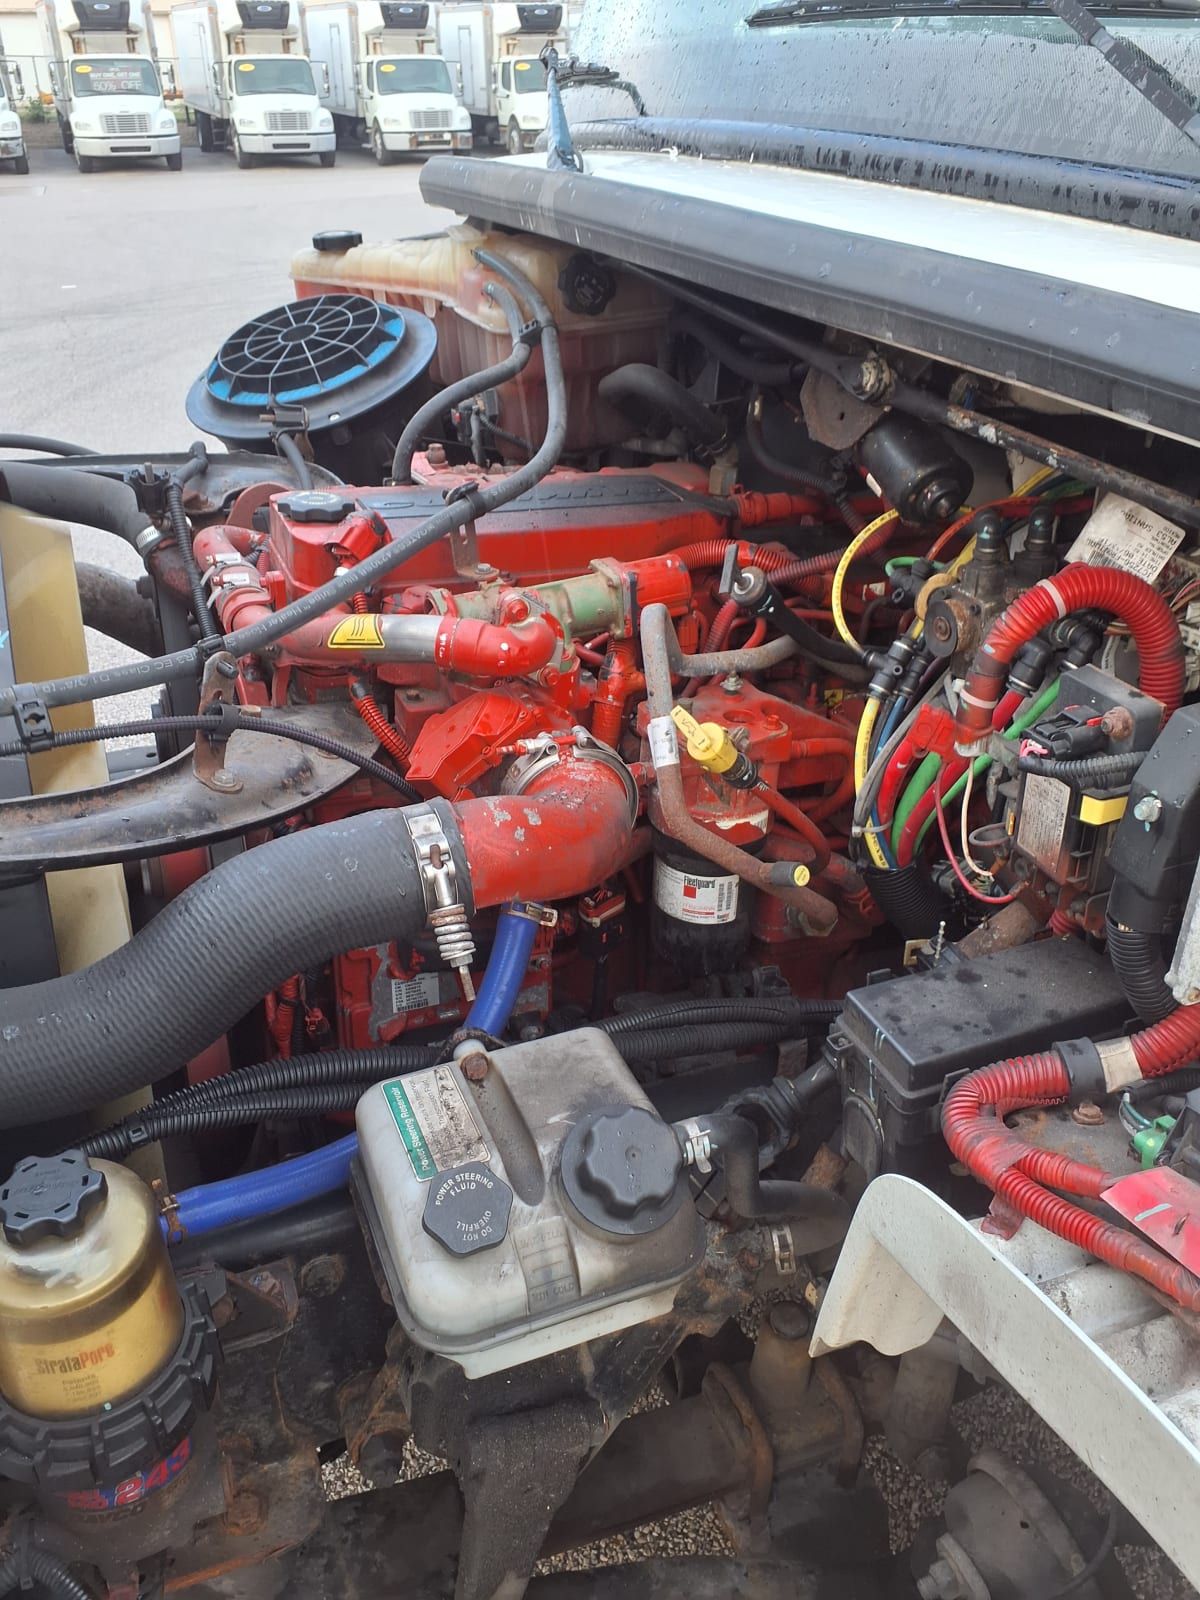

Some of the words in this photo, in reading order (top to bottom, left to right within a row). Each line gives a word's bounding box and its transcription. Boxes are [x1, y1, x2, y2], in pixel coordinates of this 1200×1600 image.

[93, 81, 116, 91] 50%
[121, 80, 142, 90] OFF
[268, 606, 302, 626] Heater
[116, 665, 149, 677] Class
[154, 660, 173, 670] EC
[684, 875, 715, 889] Fleetguard
[391, 1087, 410, 1119] Reservoir
[404, 1118, 421, 1148] Steering
[416, 1148, 432, 1172] Power
[435, 1179, 455, 1205] POWER
[455, 1172, 494, 1189] STEERING
[449, 1182, 476, 1196] FLUID
[456, 1210, 492, 1232] OVERFILL
[463, 1233, 479, 1241] NOT
[480, 1225, 493, 1237] DO
[34, 1343, 115, 1375] StrataPore
